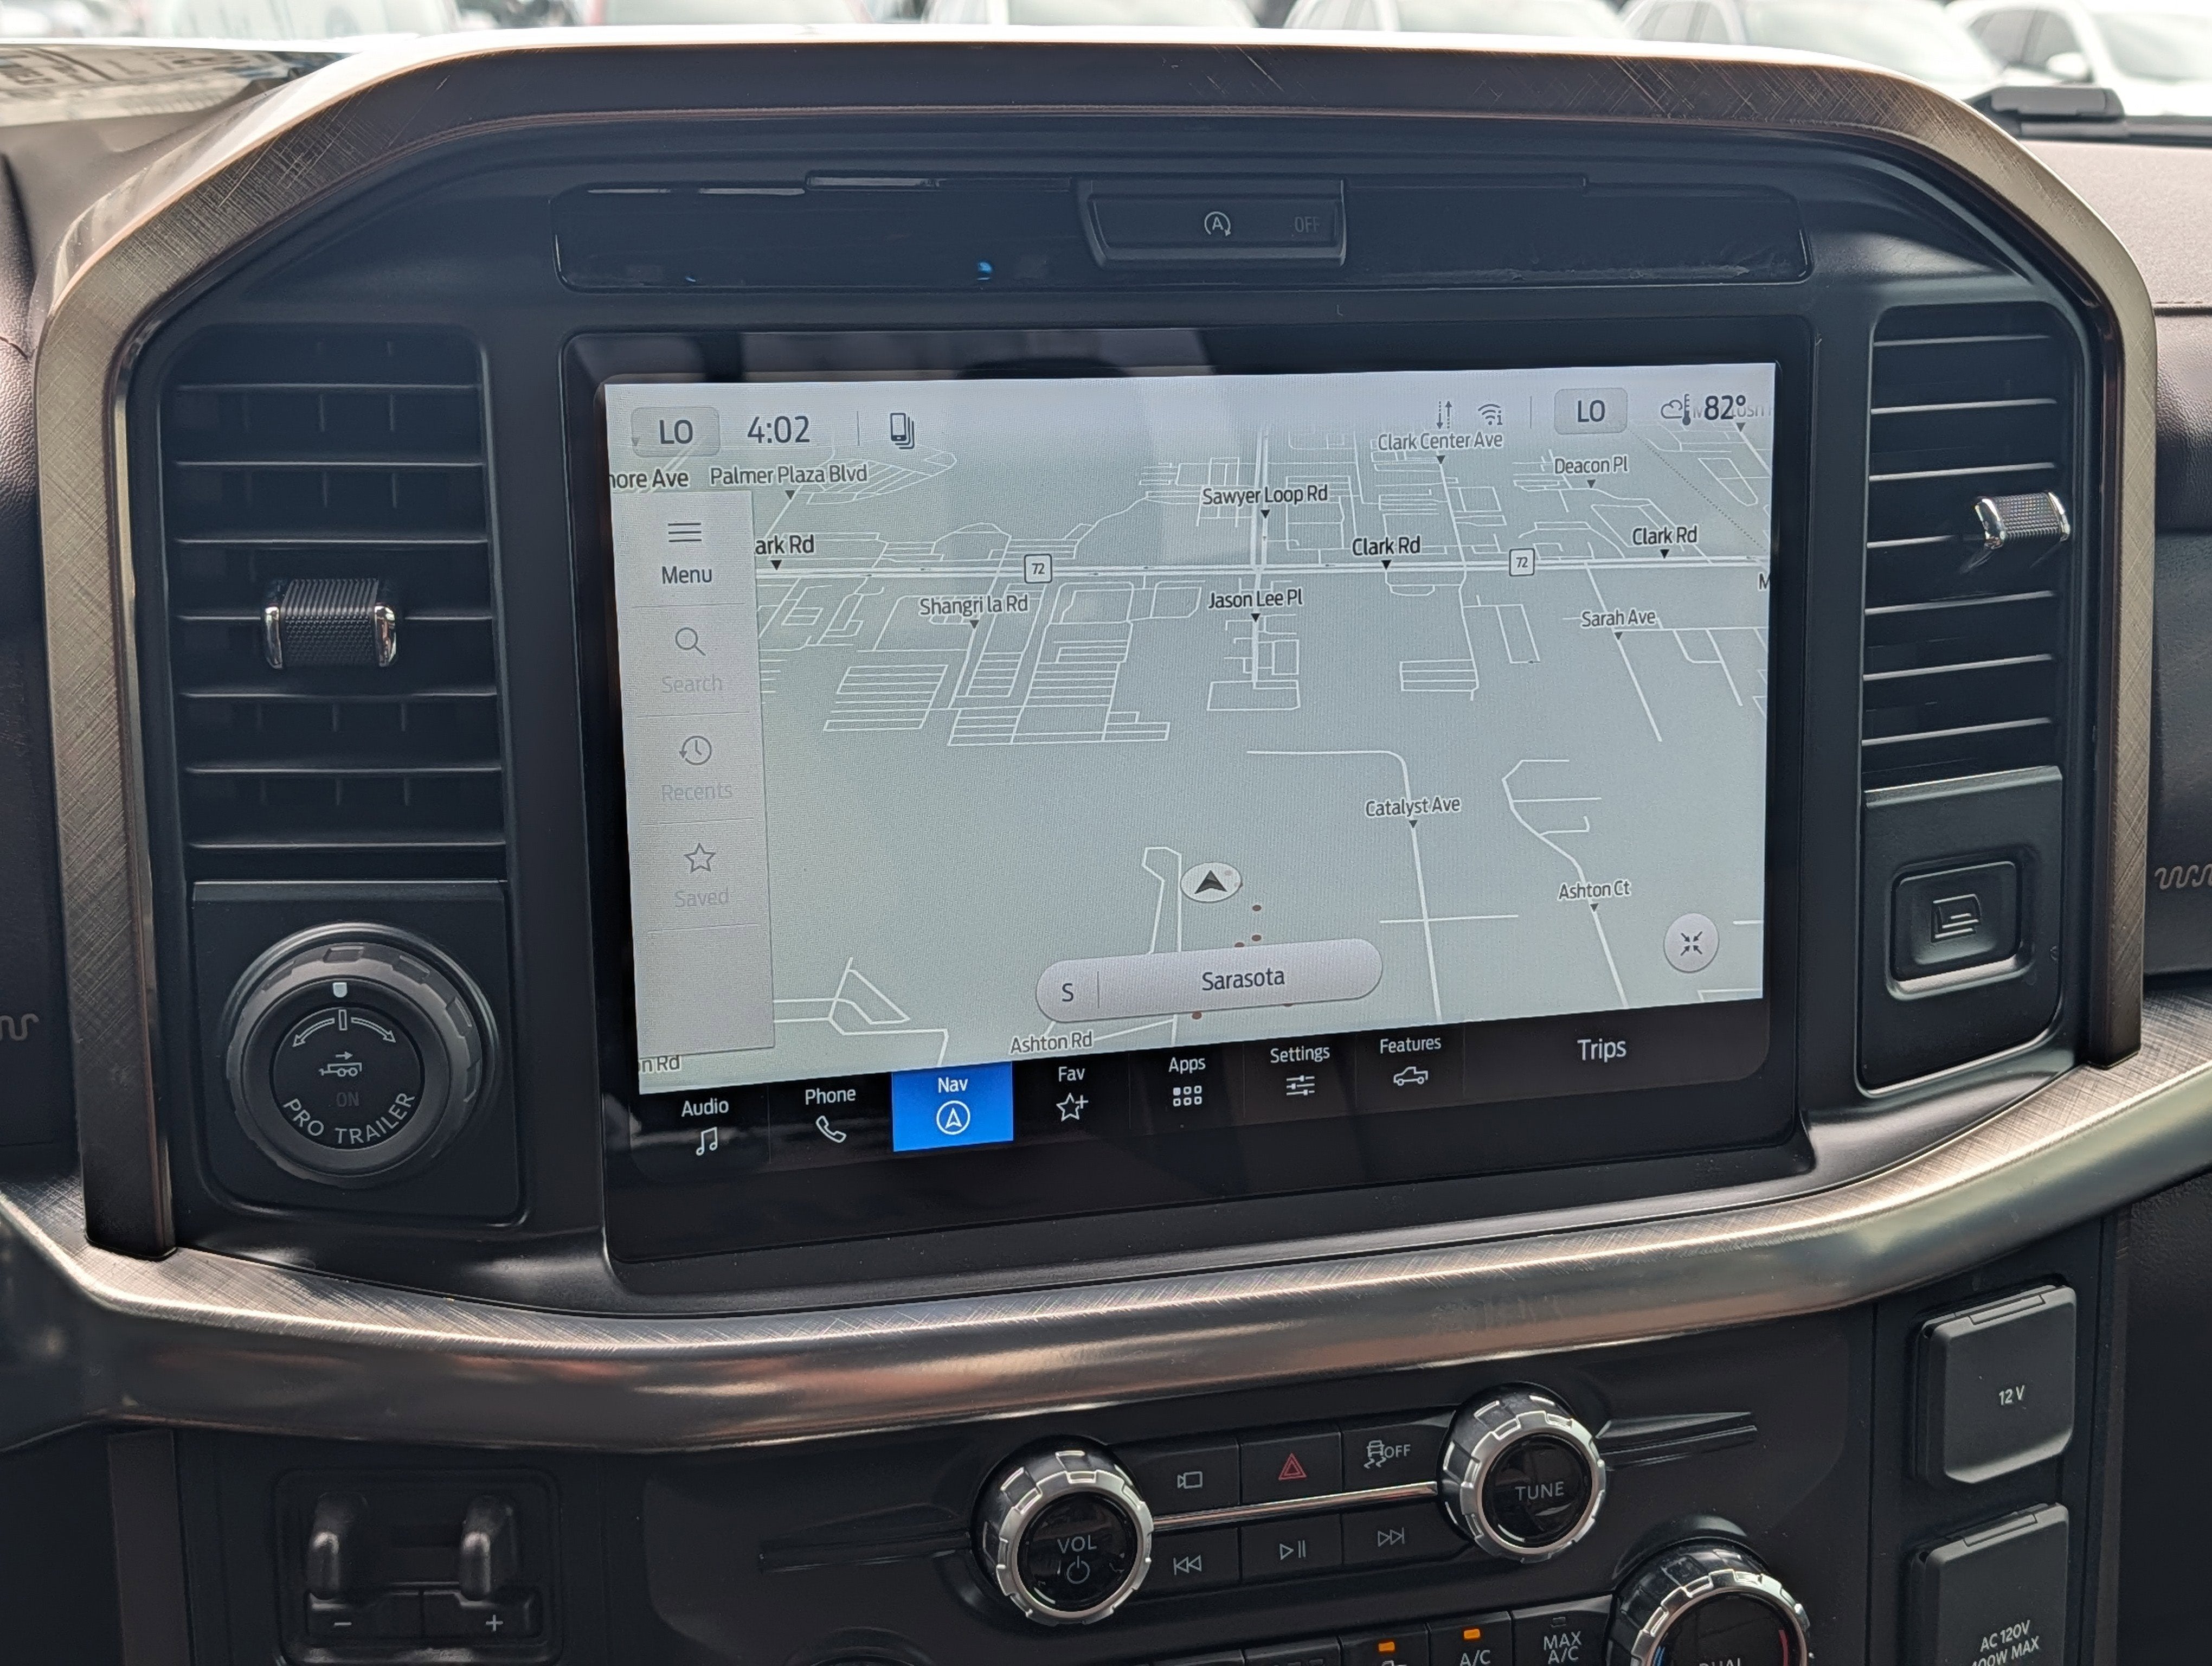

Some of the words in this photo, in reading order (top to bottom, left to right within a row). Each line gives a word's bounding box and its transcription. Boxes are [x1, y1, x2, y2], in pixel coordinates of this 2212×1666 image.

[1294, 216, 1320, 233] OFF
[1577, 400, 1605, 422] LO
[1705, 395, 1746, 420] 82°
[659, 419, 693, 444] LO
[748, 415, 811, 443] 4:02
[1378, 434, 1417, 450] Clark
[1420, 433, 1470, 449] Center
[1474, 432, 1503, 447] Ave
[711, 467, 774, 485] Palmer
[777, 465, 825, 483] Plaza
[829, 464, 867, 482] Blvd
[1554, 458, 1610, 473] Deacon
[1613, 456, 1628, 472] Pl
[652, 469, 689, 487] Ave
[1203, 488, 1261, 507] Sawyer
[1265, 486, 1303, 505] Loop
[1307, 484, 1328, 501] Rd
[789, 534, 814, 553] Rd
[1632, 528, 1672, 544] Clark
[1676, 526, 1697, 543] Rd
[1352, 537, 1394, 556] Clark
[1398, 535, 1421, 553] Rd
[1032, 563, 1045, 574] 72
[1516, 557, 1528, 568] 72
[662, 566, 712, 584] Menu
[920, 598, 983, 617] Shangri
[1007, 594, 1027, 612] Rd
[1208, 592, 1253, 608] Jason
[1257, 591, 1283, 606] Lee
[1288, 588, 1302, 605] Pl
[1582, 611, 1624, 627] Sarah
[1628, 610, 1656, 625] Ave
[662, 674, 723, 694] Search
[662, 783, 733, 803] Recents
[1365, 799, 1429, 817] Catalyst
[1431, 798, 1461, 812] Ave
[674, 888, 729, 908] Saved
[1558, 882, 1610, 900] Ashton
[1613, 880, 1630, 896] Ct
[1201, 967, 1285, 991] Sarasota
[1062, 983, 1074, 1002] S
[1011, 1035, 1068, 1054] Ashton
[1070, 1031, 1092, 1049] Rd
[1380, 1035, 1442, 1055] Features
[1577, 1038, 1627, 1063] Trips
[657, 1055, 679, 1071] Rd
[1168, 1055, 1206, 1075] Apps
[1270, 1045, 1330, 1065] Settings
[1058, 1066, 1085, 1082] Fav
[938, 1077, 968, 1093] Nav
[336, 1092, 359, 1107] ON
[805, 1087, 857, 1105] Phone
[282, 1098, 325, 1137] PRO
[334, 1092, 416, 1144] TRAILER
[681, 1098, 730, 1118] Audio
[1998, 1389, 2012, 1406] 12
[2015, 1385, 2025, 1401] V
[1384, 1444, 1411, 1459] OFF
[1515, 1481, 1564, 1501] TUNE
[1057, 1535, 1097, 1554] VOL
[1544, 1631, 1582, 1650] MAX
[1980, 1633, 1998, 1652] AC
[2000, 1619, 2030, 1644] 120V
[1548, 1646, 1579, 1664] A/C
[2011, 1636, 2040, 1660] MAX
